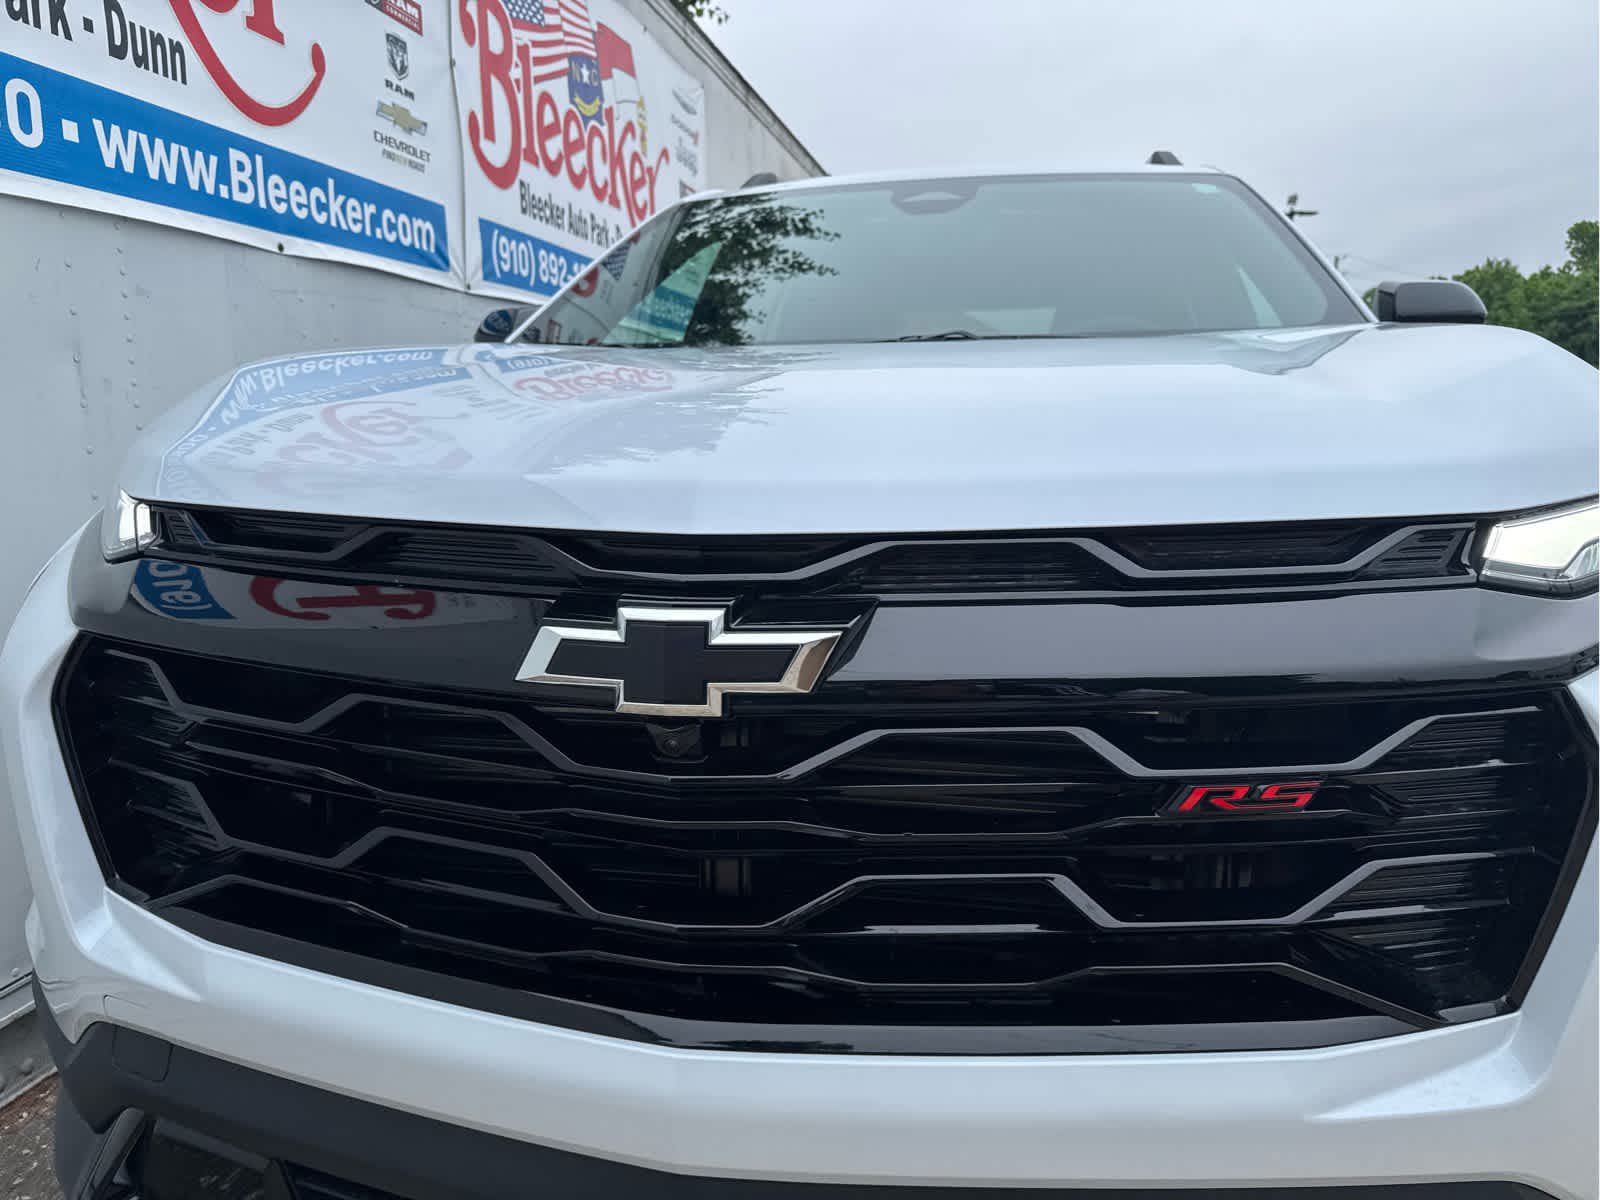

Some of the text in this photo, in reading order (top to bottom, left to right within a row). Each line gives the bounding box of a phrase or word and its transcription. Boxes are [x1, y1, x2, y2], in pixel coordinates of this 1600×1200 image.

[103, 0, 188, 86] Dunn
[384, 79, 415, 100] RAM
[458, 0, 669, 228] Bleecker
[373, 130, 431, 162] CHEVROLET
[93, 118, 437, 254] www.Bleecker.com
[519, 179, 565, 232] Bleecker
[567, 201, 589, 240] Auto
[589, 211, 610, 249] Park
[492, 228, 536, 287] (910)
[1176, 781, 1321, 811] RS
